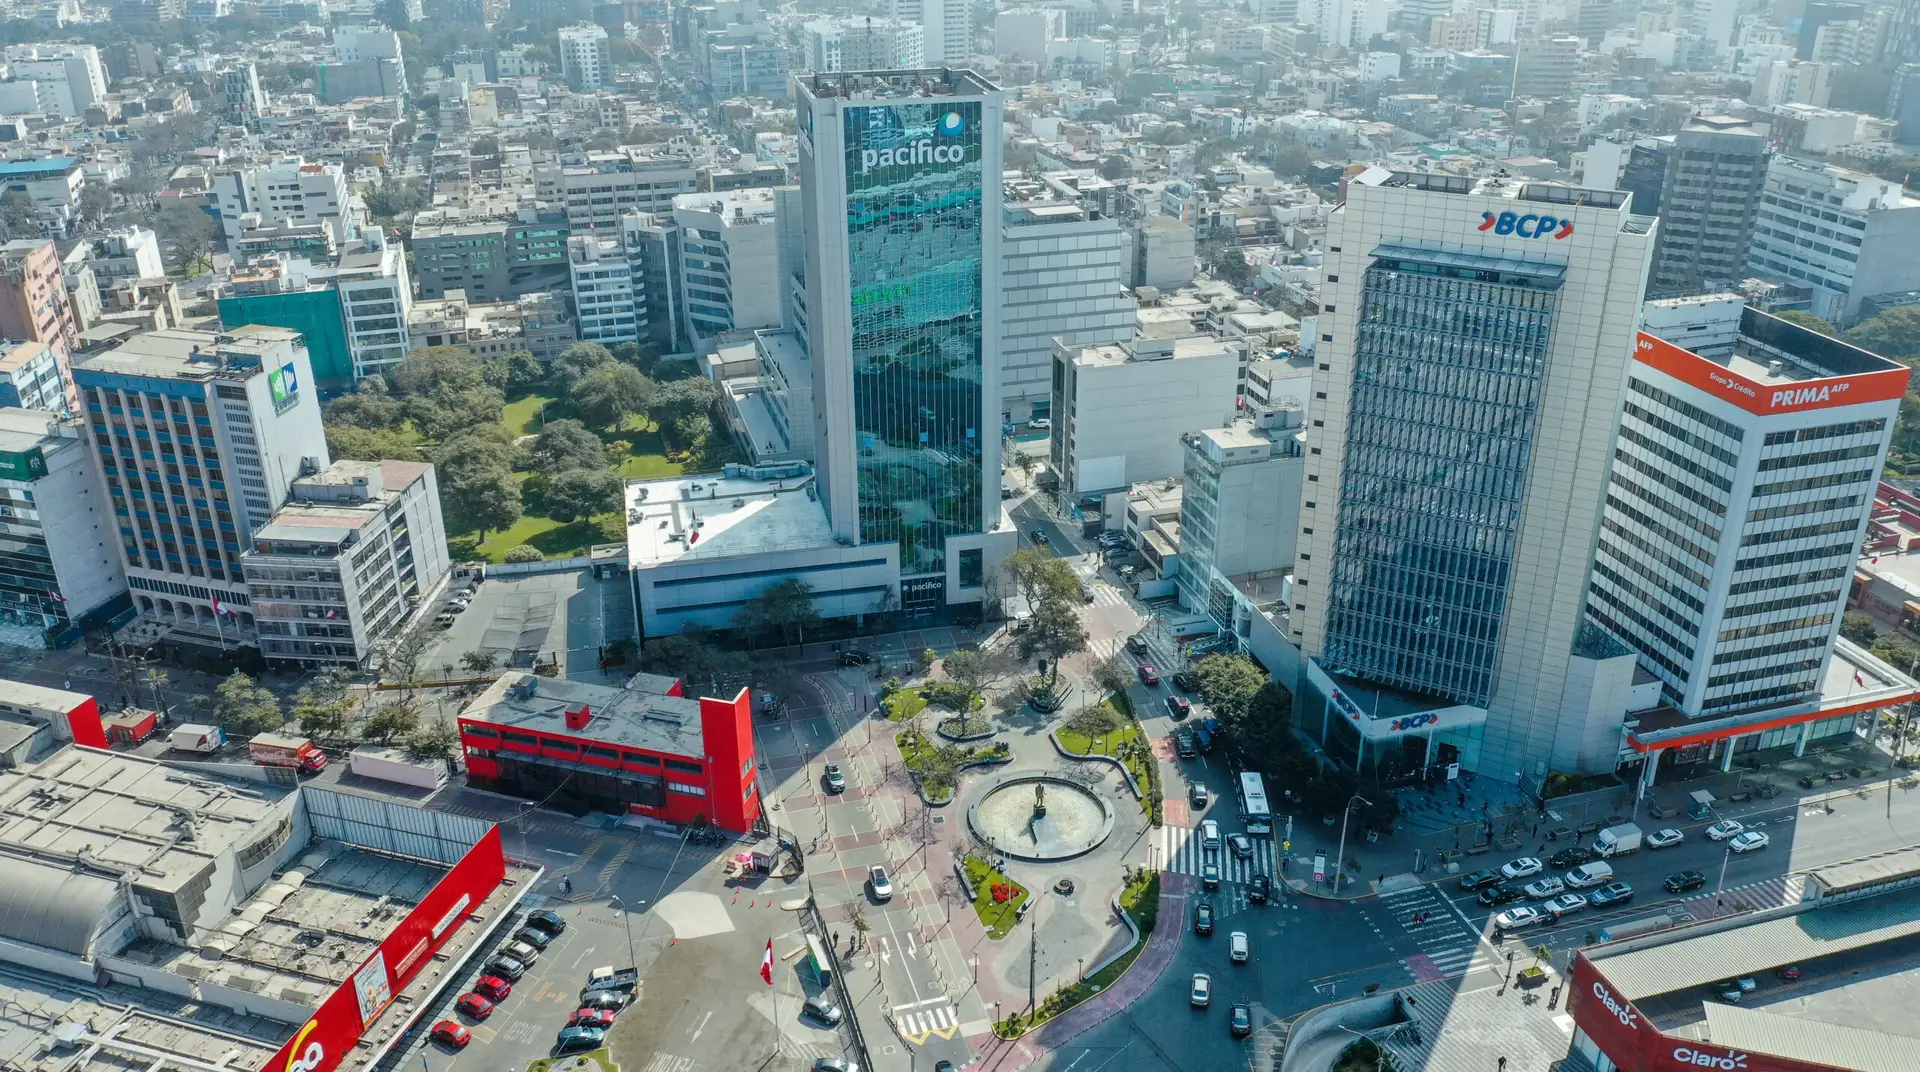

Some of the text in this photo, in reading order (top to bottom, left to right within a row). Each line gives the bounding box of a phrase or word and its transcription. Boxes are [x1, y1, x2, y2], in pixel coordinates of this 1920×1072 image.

[1495, 211, 1557, 239] BCP
[1639, 340, 1653, 350] AFP
[1709, 372, 1756, 398] Grupo Crédito
[1770, 383, 1850, 407] PRIMA AFP
[1399, 713, 1431, 730] BCP
[1593, 982, 1631, 1026] Claro
[1673, 1048, 1735, 1070] Claro
